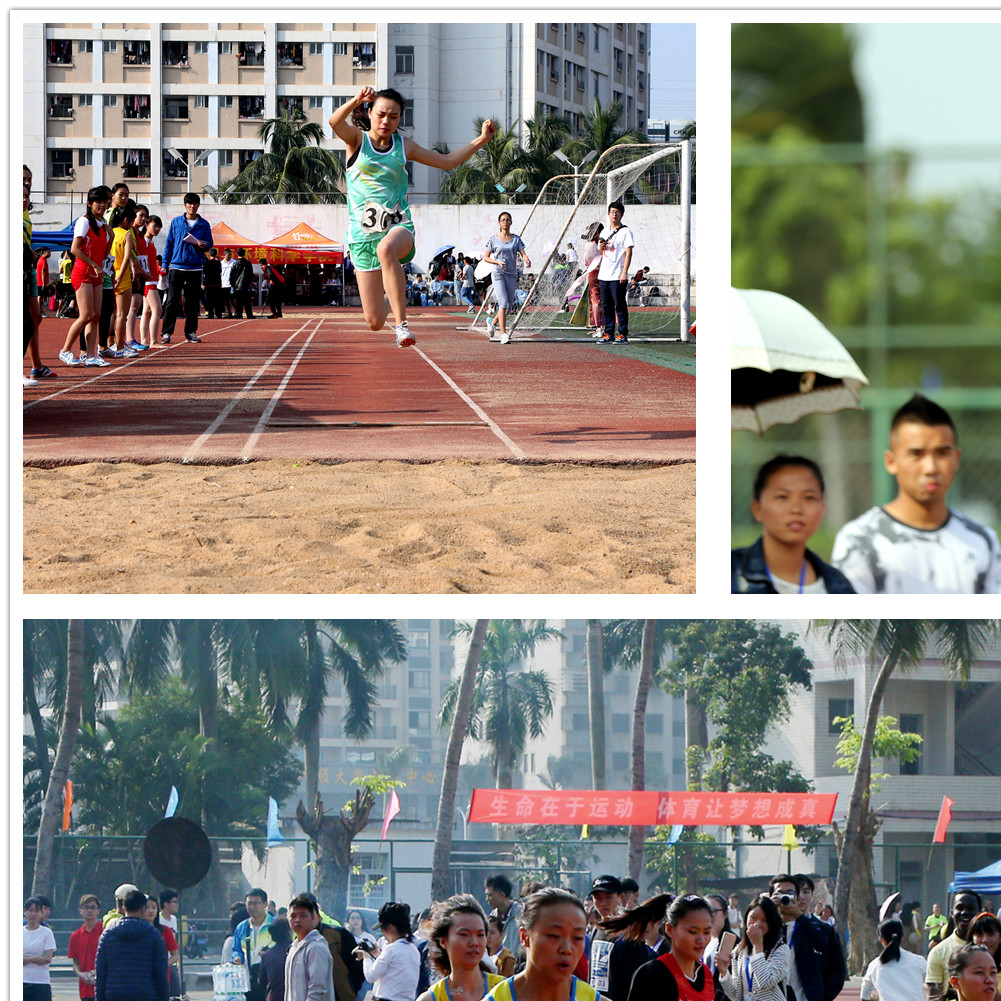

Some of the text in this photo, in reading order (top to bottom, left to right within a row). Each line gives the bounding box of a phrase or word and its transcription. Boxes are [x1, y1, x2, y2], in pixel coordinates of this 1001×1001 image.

[489, 795, 819, 819] 生命在于运动 体育让梦想成真
